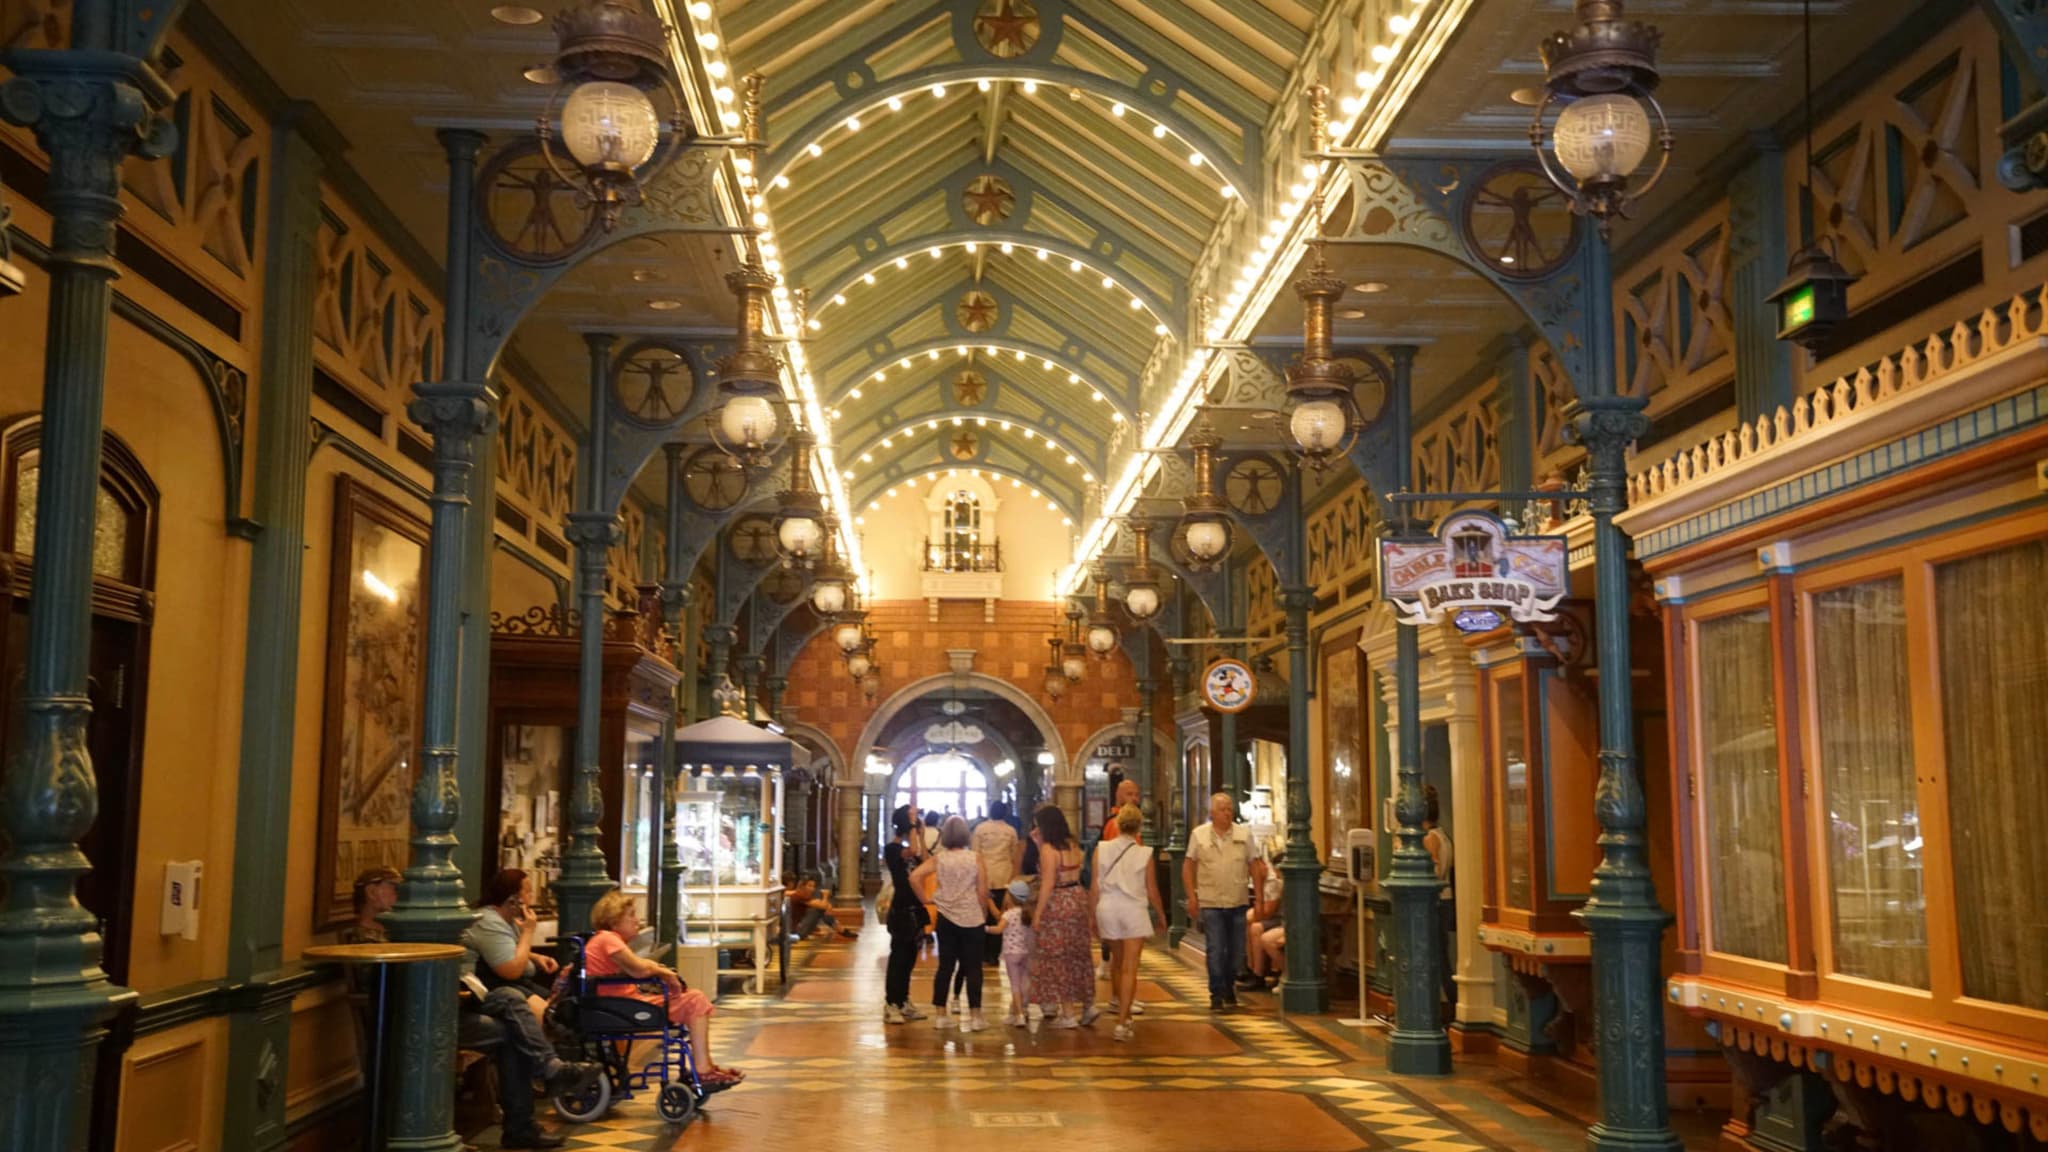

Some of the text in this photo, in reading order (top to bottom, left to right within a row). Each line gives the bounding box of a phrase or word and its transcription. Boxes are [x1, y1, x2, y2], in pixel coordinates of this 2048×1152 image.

[1392, 553, 1446, 586] CABLE
[1424, 582, 1530, 609] BAKE SHOP
[1097, 746, 1130, 757] DELI
